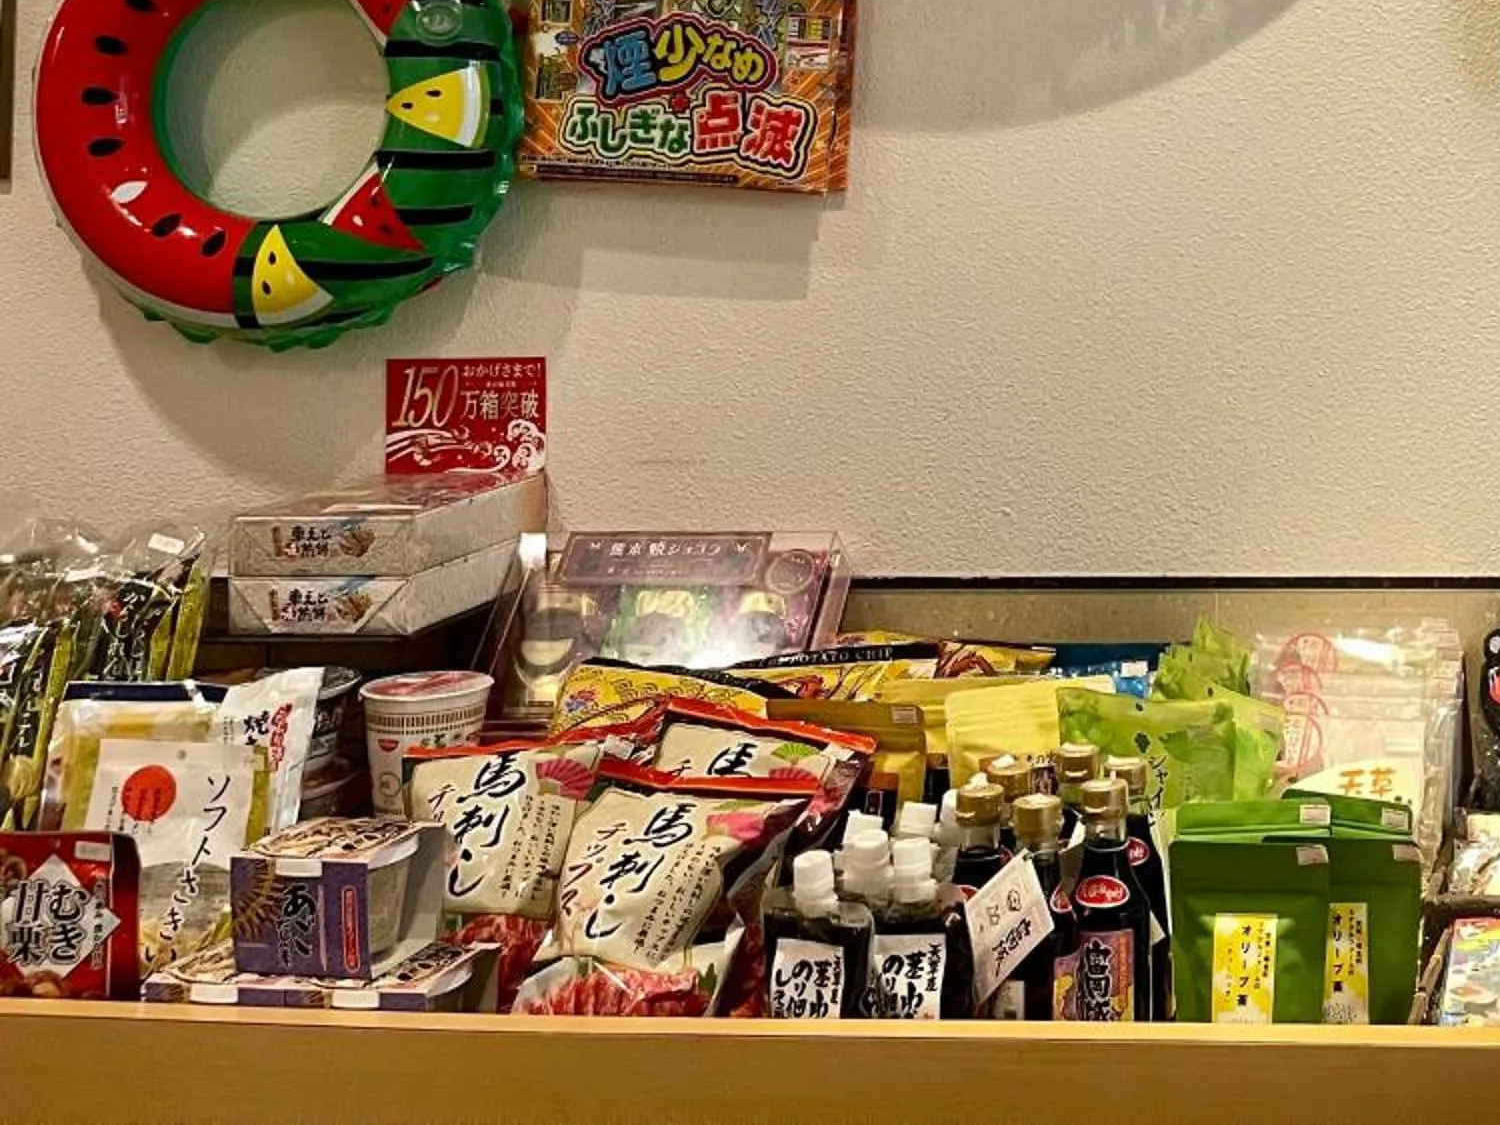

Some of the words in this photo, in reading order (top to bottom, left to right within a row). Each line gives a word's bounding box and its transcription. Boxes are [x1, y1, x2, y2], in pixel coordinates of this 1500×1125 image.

[600, 25, 766, 97] 煙少なめ
[567, 92, 804, 167] ふしぎな点滅
[392, 365, 459, 428] 150
[460, 388, 541, 420] 万箱突破
[1338, 767, 1395, 797] 天草
[449, 748, 527, 897] 馬刺し
[145, 775, 231, 963] ソフトさきい
[561, 822, 627, 917] チップス
[583, 802, 697, 939] 馬刺し
